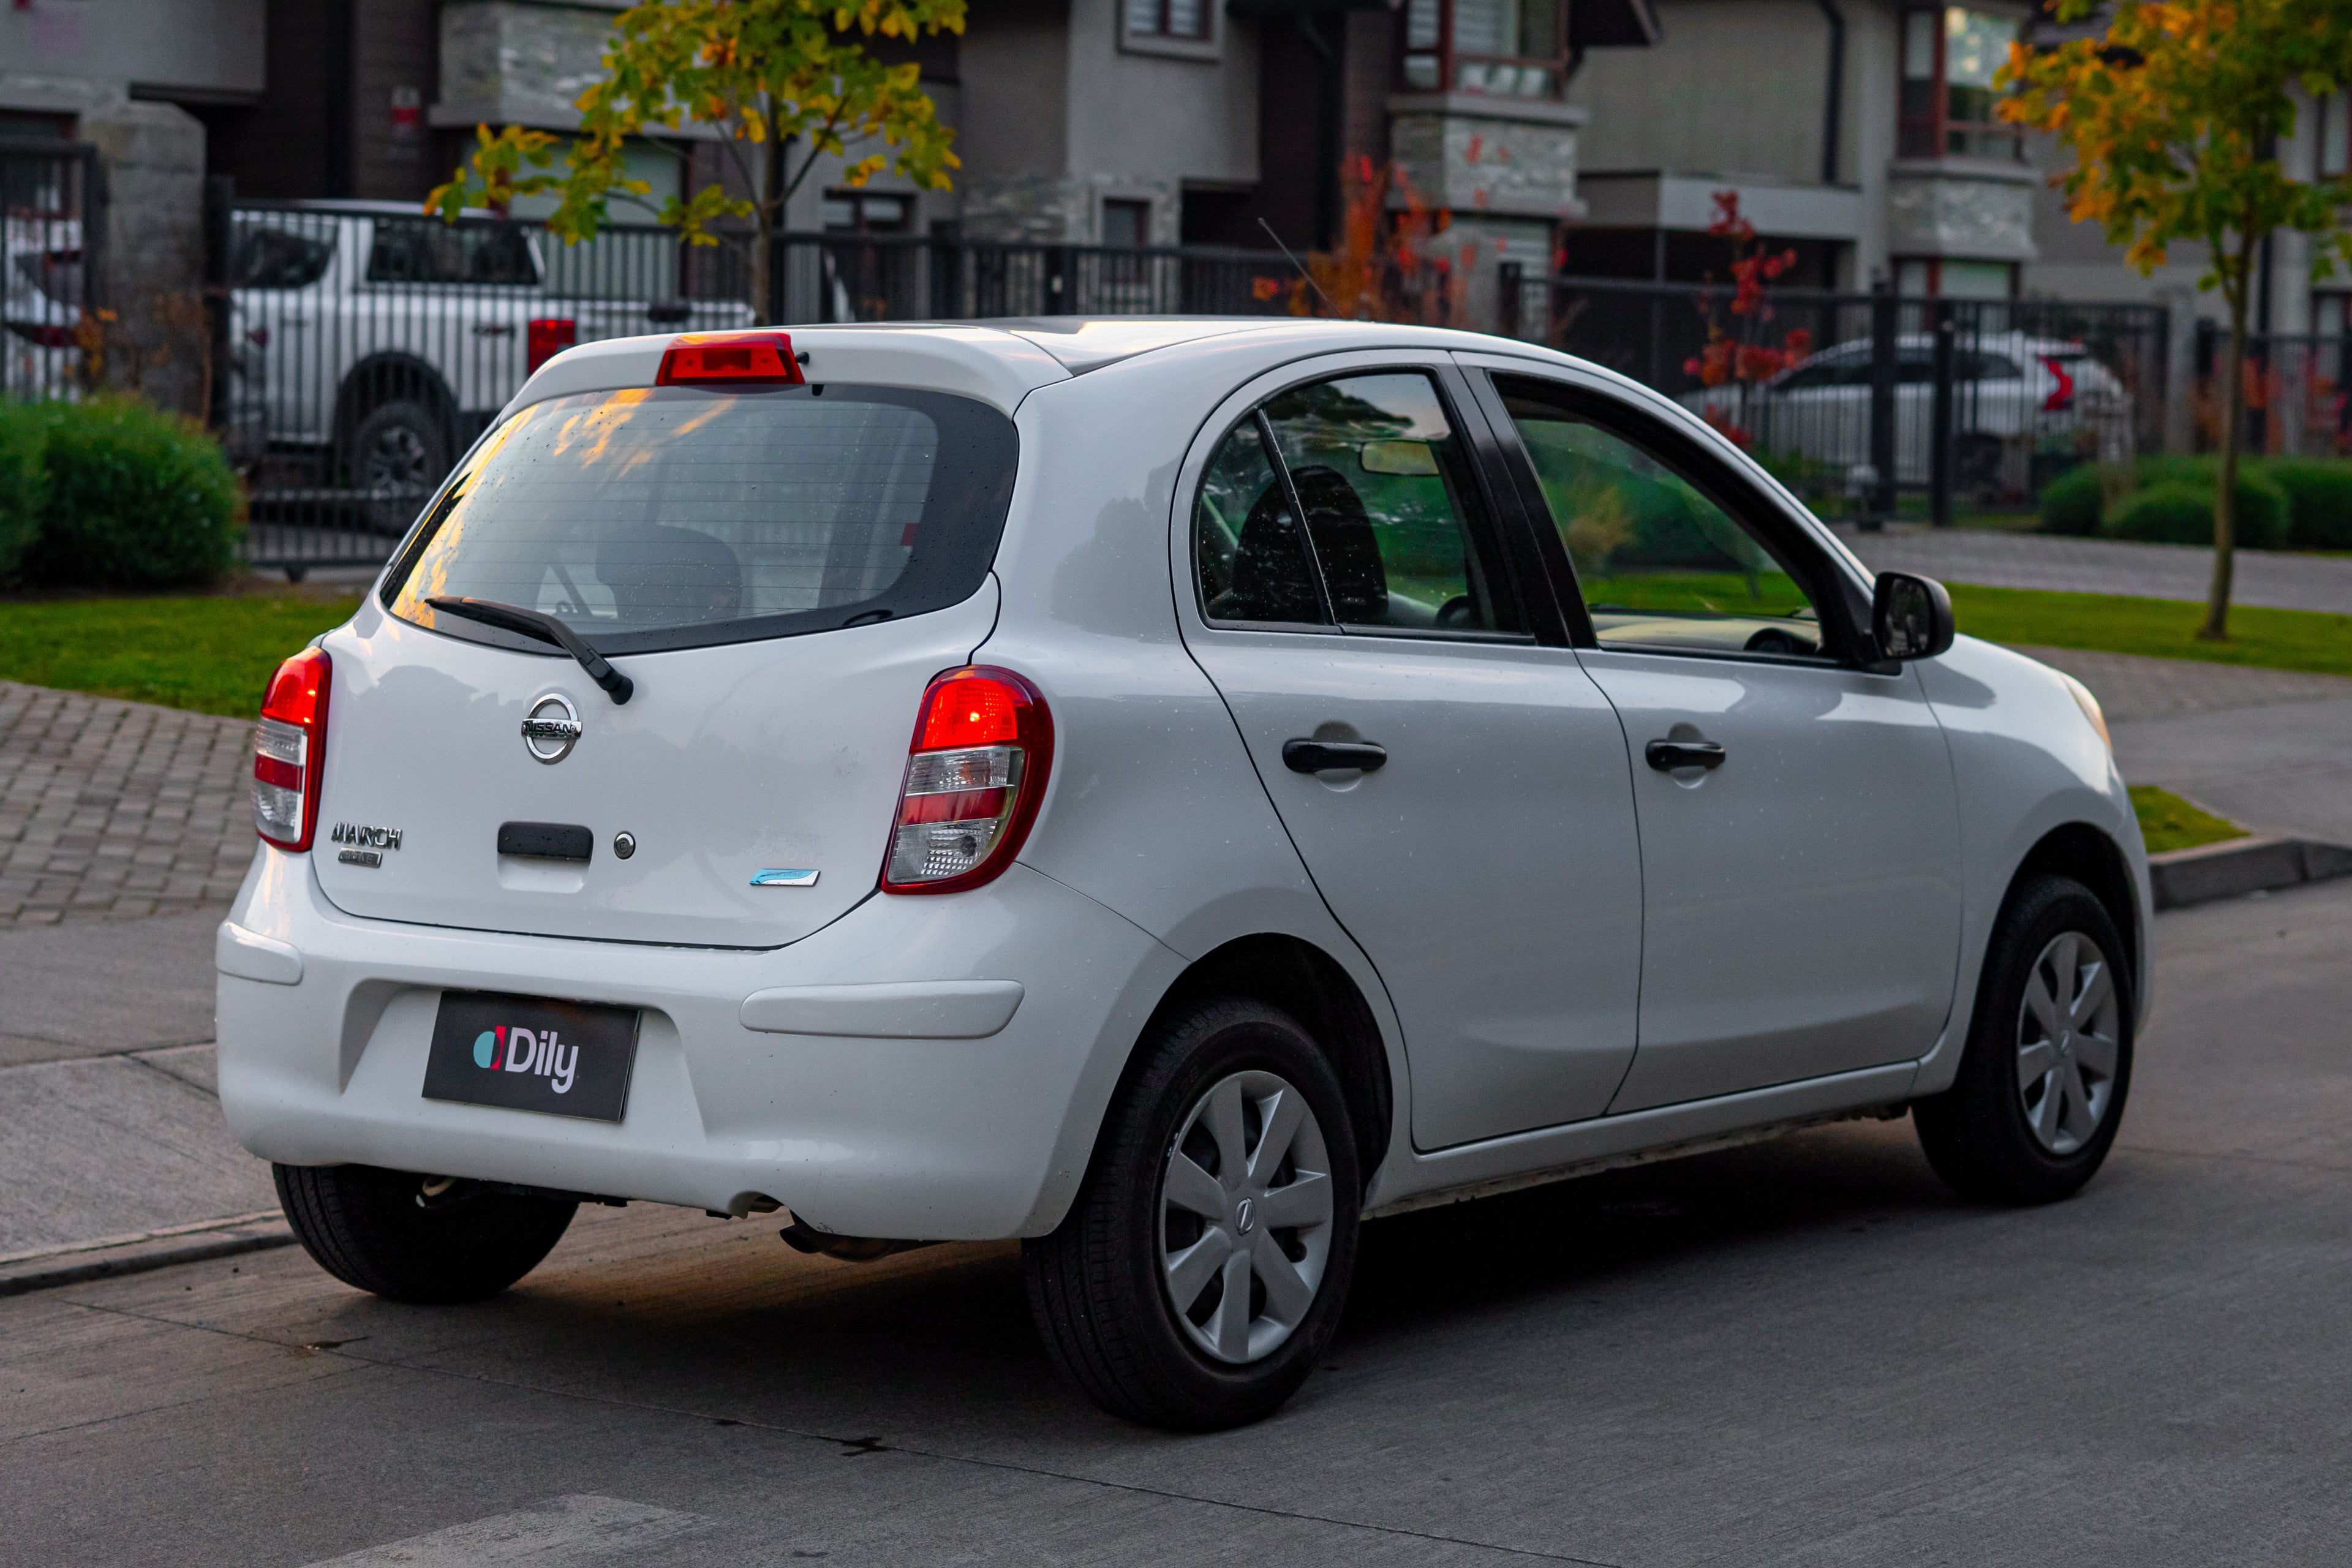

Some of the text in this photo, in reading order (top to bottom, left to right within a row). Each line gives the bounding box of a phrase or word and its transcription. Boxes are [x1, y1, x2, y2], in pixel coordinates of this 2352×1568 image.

[525, 720, 571, 734] NISSAN
[331, 822, 402, 851] MARCH
[505, 1027, 579, 1094] Dily
